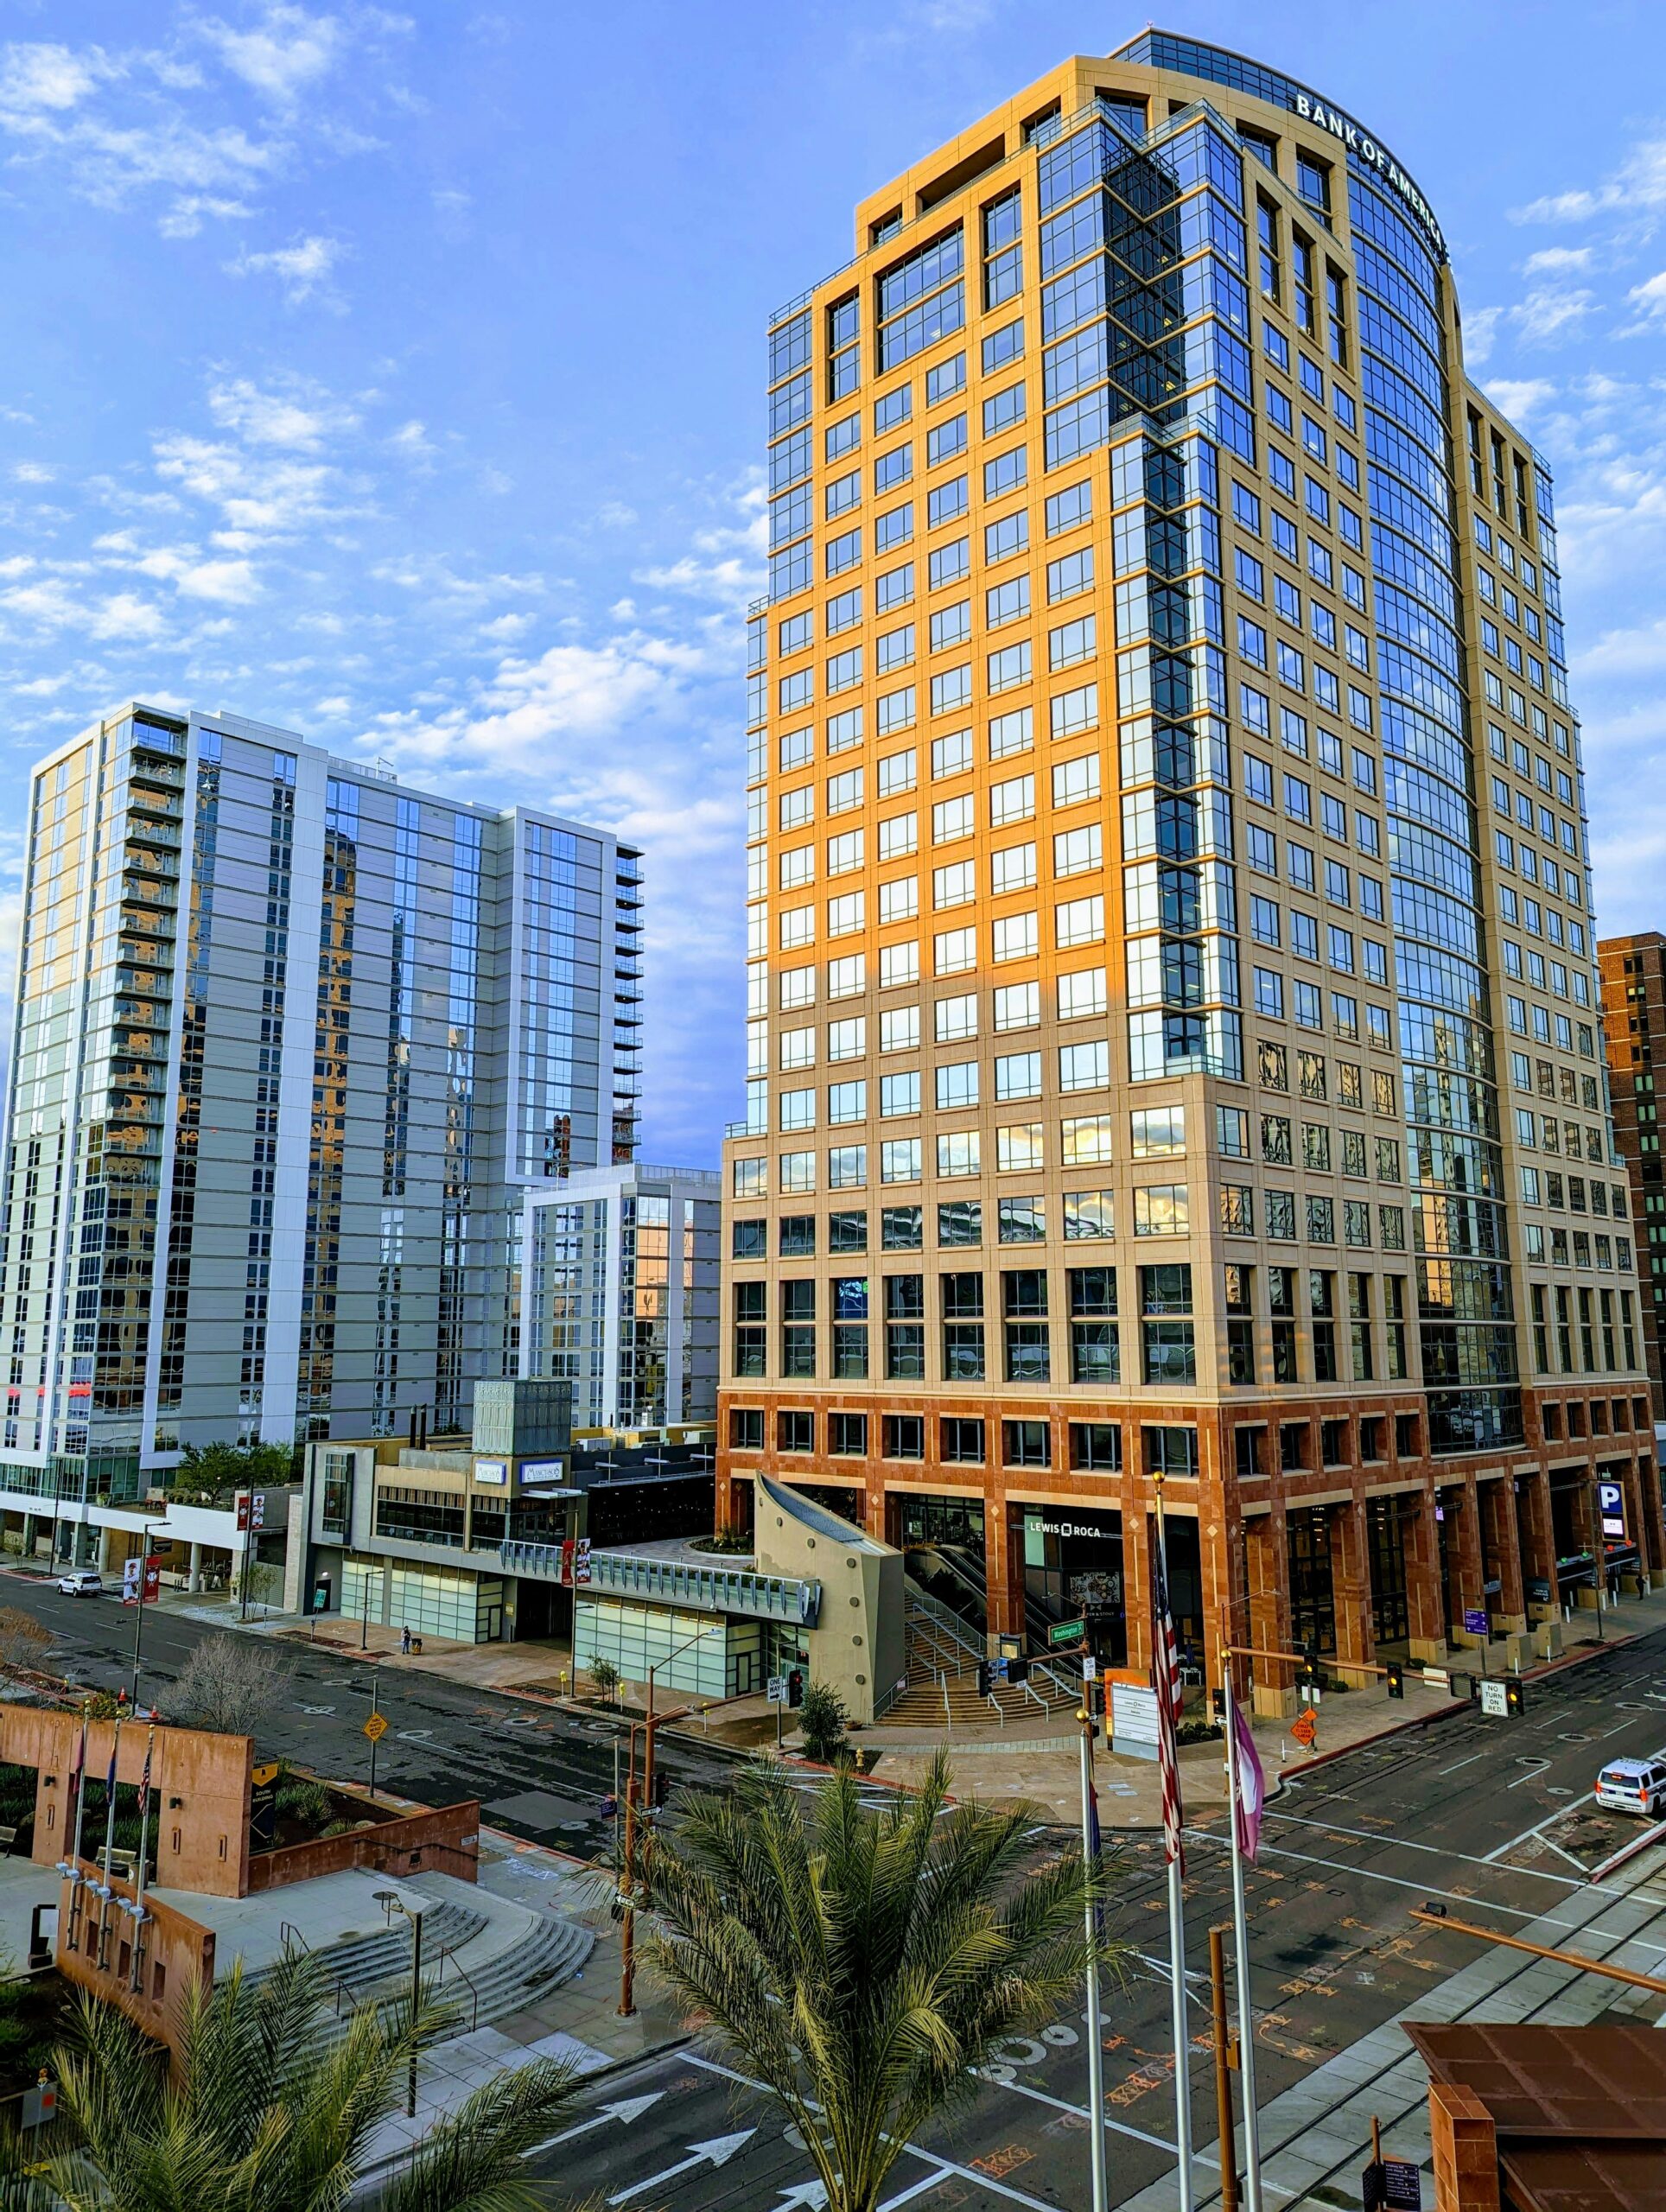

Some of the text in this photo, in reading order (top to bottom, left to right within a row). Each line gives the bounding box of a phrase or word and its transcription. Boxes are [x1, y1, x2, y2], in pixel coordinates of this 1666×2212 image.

[1297, 93, 1441, 250] BANK OF AMERICA
[1600, 1485, 1619, 1509] P
[1030, 1522, 1100, 1537] LEWIS ROCA
[1054, 1627, 1078, 1638] Washington
[770, 1677, 780, 1686] ONE
[252, 1794, 274, 1803] BUILDING
